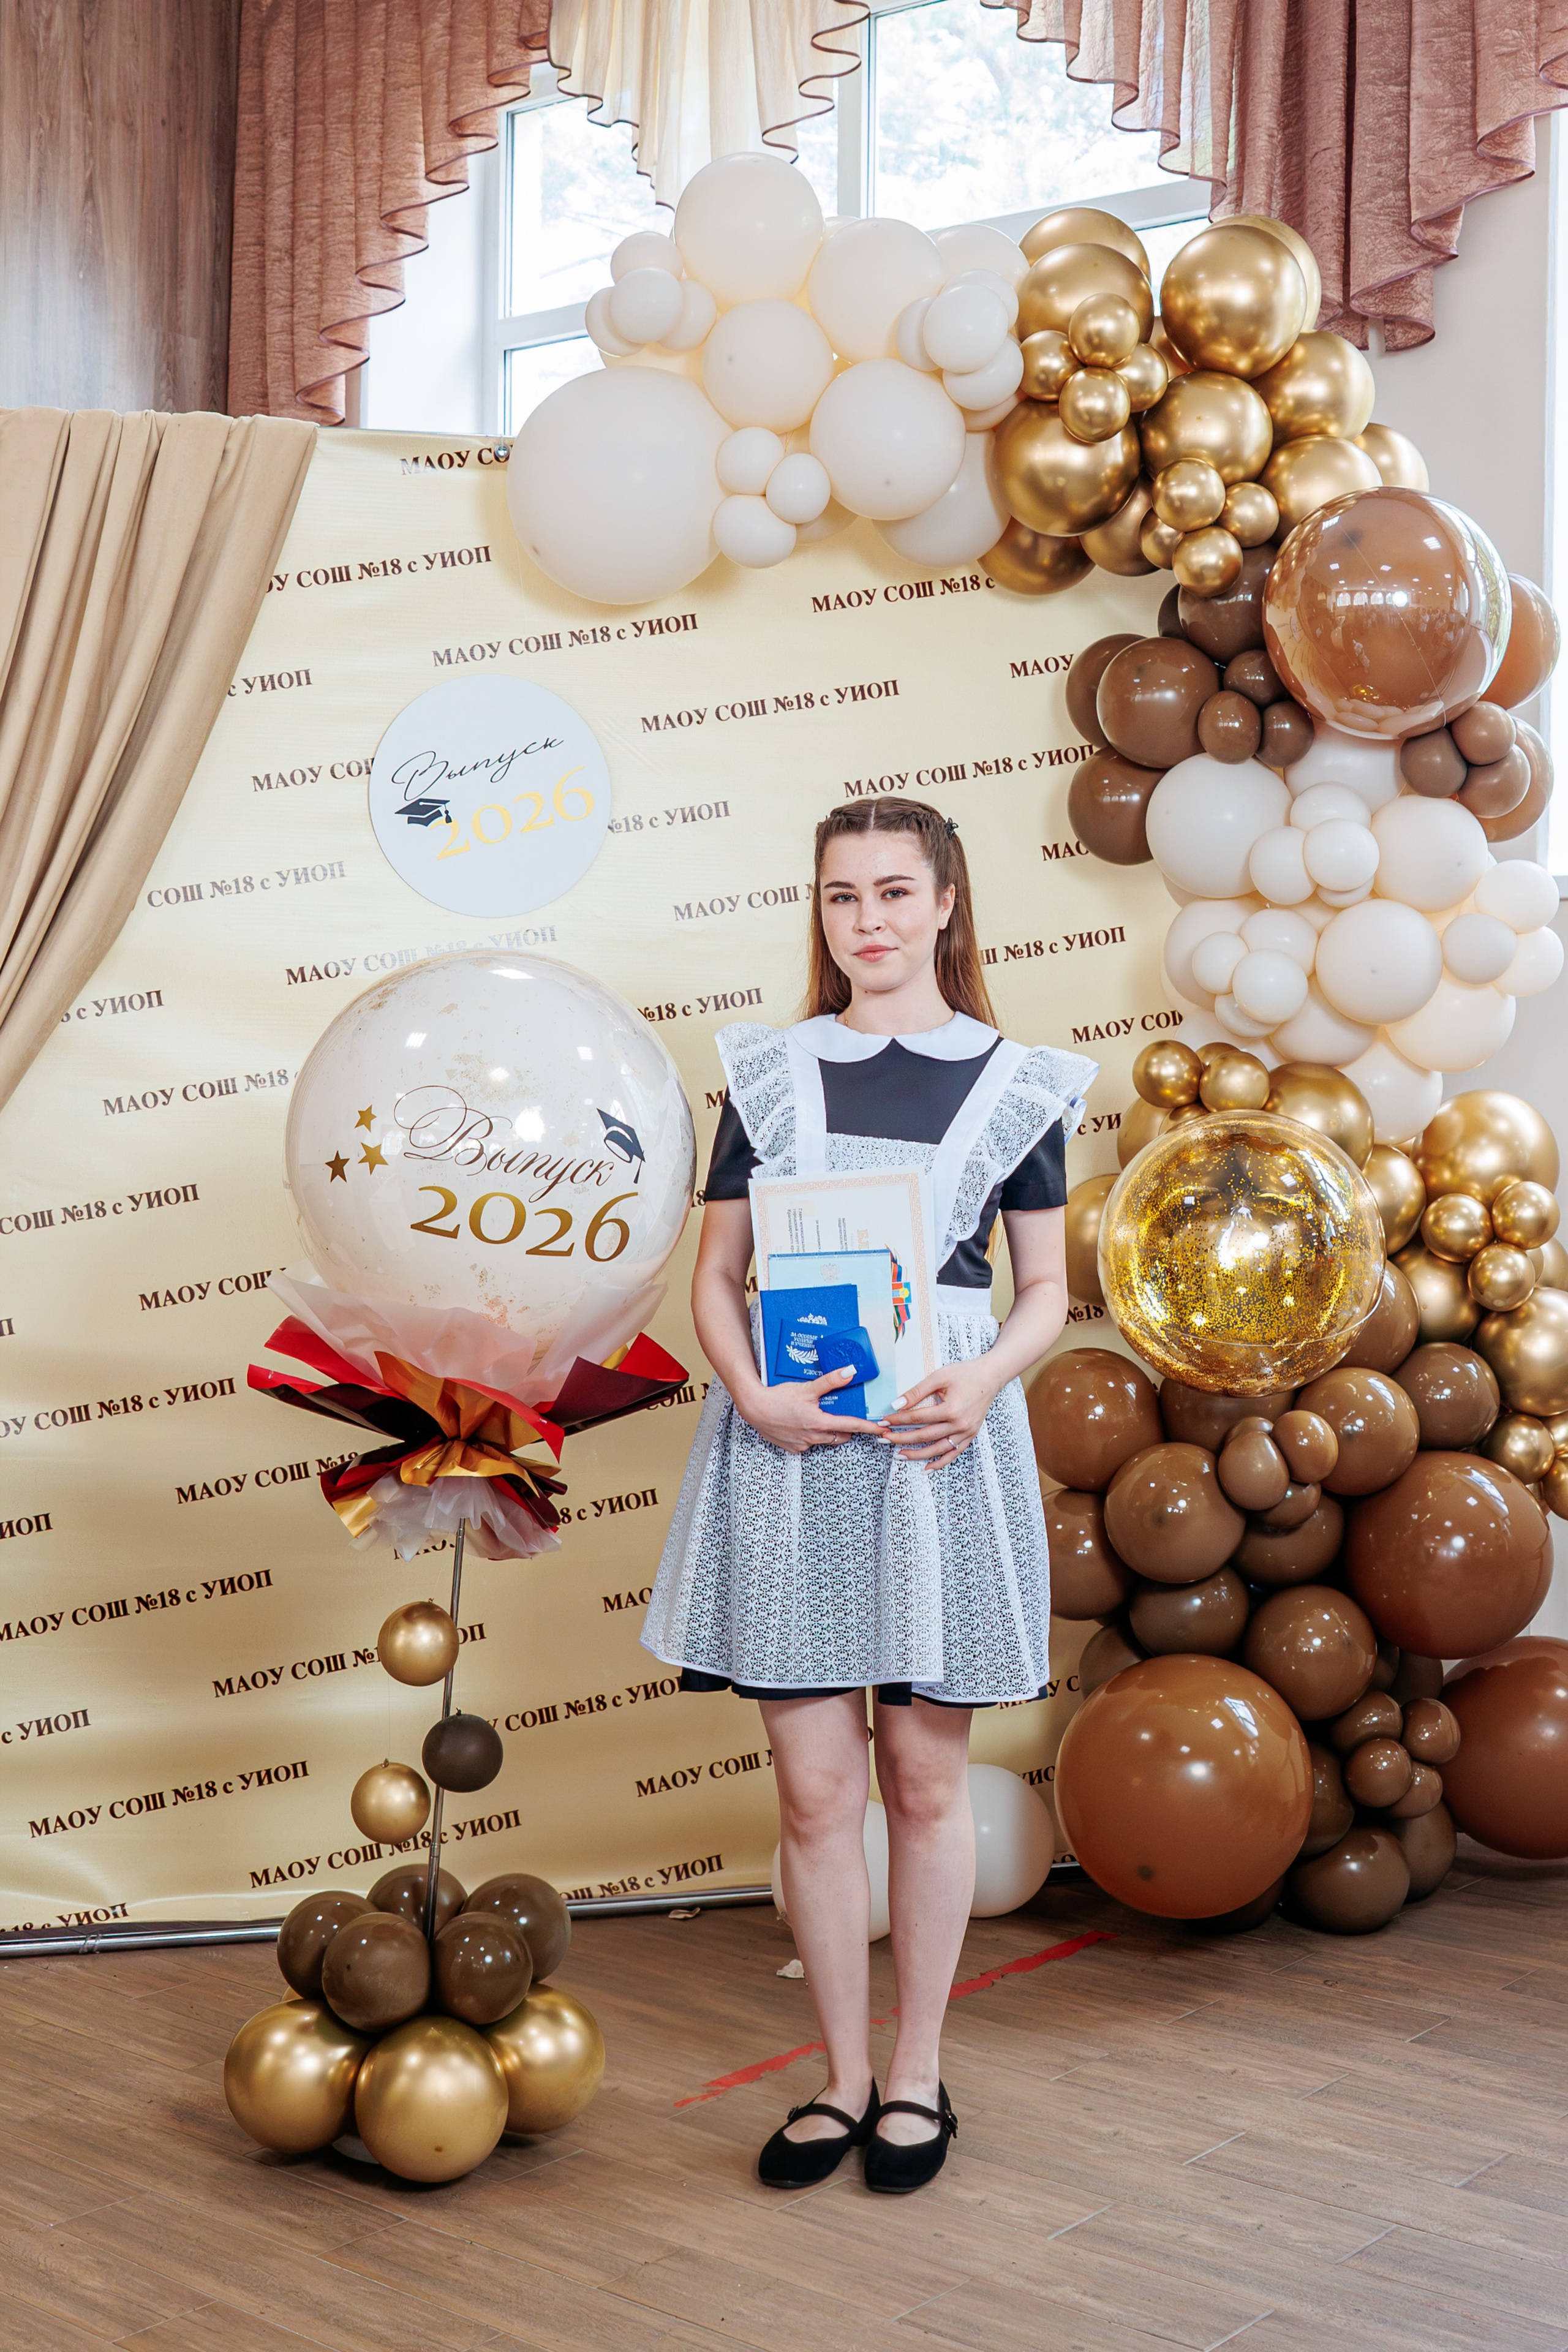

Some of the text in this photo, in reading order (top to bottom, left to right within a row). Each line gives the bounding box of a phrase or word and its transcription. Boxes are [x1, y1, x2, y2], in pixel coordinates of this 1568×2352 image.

[400, 450, 471, 475] МАОУ
[296, 565, 352, 588] СОШ
[357, 558, 402, 581] №18
[407, 561, 418, 573] с
[421, 546, 492, 570] УИОП
[810, 589, 877, 612] МАОУ
[884, 581, 935, 602] СОШ
[940, 575, 981, 595] №18
[432, 613, 698, 666] МАОУ СОШ №18 с УИОП
[241, 669, 312, 694] УИОП
[1009, 654, 1074, 678] МАОУ
[641, 680, 900, 733] МАОУ СОШ №18 с УИОП
[251, 766, 322, 792] МАОУ
[391, 737, 565, 801] Выпуск
[843, 772, 910, 797] МАОУ
[916, 764, 967, 786] СОШ
[973, 757, 1014, 778] №18
[1019, 759, 1028, 771] с
[429, 765, 595, 861] 2026
[649, 817, 658, 827] с
[663, 801, 730, 826] УИОП
[148, 861, 345, 907] СОШ №18 с УИОП
[673, 895, 741, 921] МАОУ
[747, 886, 800, 908] СОШ
[1003, 940, 1044, 962] №18
[1049, 941, 1058, 954] с
[1062, 926, 1126, 951] УИОП
[285, 958, 356, 985] МАОУ
[77, 1008, 87, 1019] с
[91, 990, 164, 1017] УИОП
[682, 1003, 692, 1016] с
[695, 988, 763, 1014] УИОП
[1071, 1017, 1135, 1044] МАОУ
[102, 1069, 288, 1115] МАОУ СОШ №18
[393, 1085, 614, 1204] Выпуск
[0, 1184, 200, 1235] СОШ №18 с УИОП
[410, 1185, 639, 1262] 2026
[138, 1281, 211, 1311] МАОУ
[34, 1404, 92, 1430] СОШ
[96, 1395, 143, 1419] №18
[149, 1396, 160, 1409] с
[163, 1378, 236, 1406] УИОП
[175, 1474, 247, 1504] МАОУ
[255, 1461, 312, 1488] СОШ
[576, 1509, 587, 1520] с
[590, 1488, 659, 1517] УИОП
[72, 1599, 130, 1626] СОШ
[134, 1589, 181, 1614] №18
[186, 1590, 197, 1602] с
[200, 1569, 273, 1599] УИОП
[212, 1666, 284, 1698] МАОУ
[291, 1653, 348, 1680] СОШ
[1, 1709, 91, 1744] с УИОП
[505, 1705, 560, 1732] СОШ
[564, 1694, 608, 1719] №18
[612, 1695, 623, 1707] с
[635, 1765, 703, 1797] МАОУ
[709, 1752, 762, 1779] СОШ
[28, 1760, 309, 1838] МАОУ СОШ №18 с УИОП
[249, 1856, 321, 1888] МАОУ
[328, 1843, 383, 1869] СОШ
[451, 1809, 522, 1841] УИОП
[598, 1876, 641, 1898] №18
[644, 1877, 655, 1888] с
[657, 1854, 724, 1885] УИОП
[56, 1902, 130, 1928] УИОП
